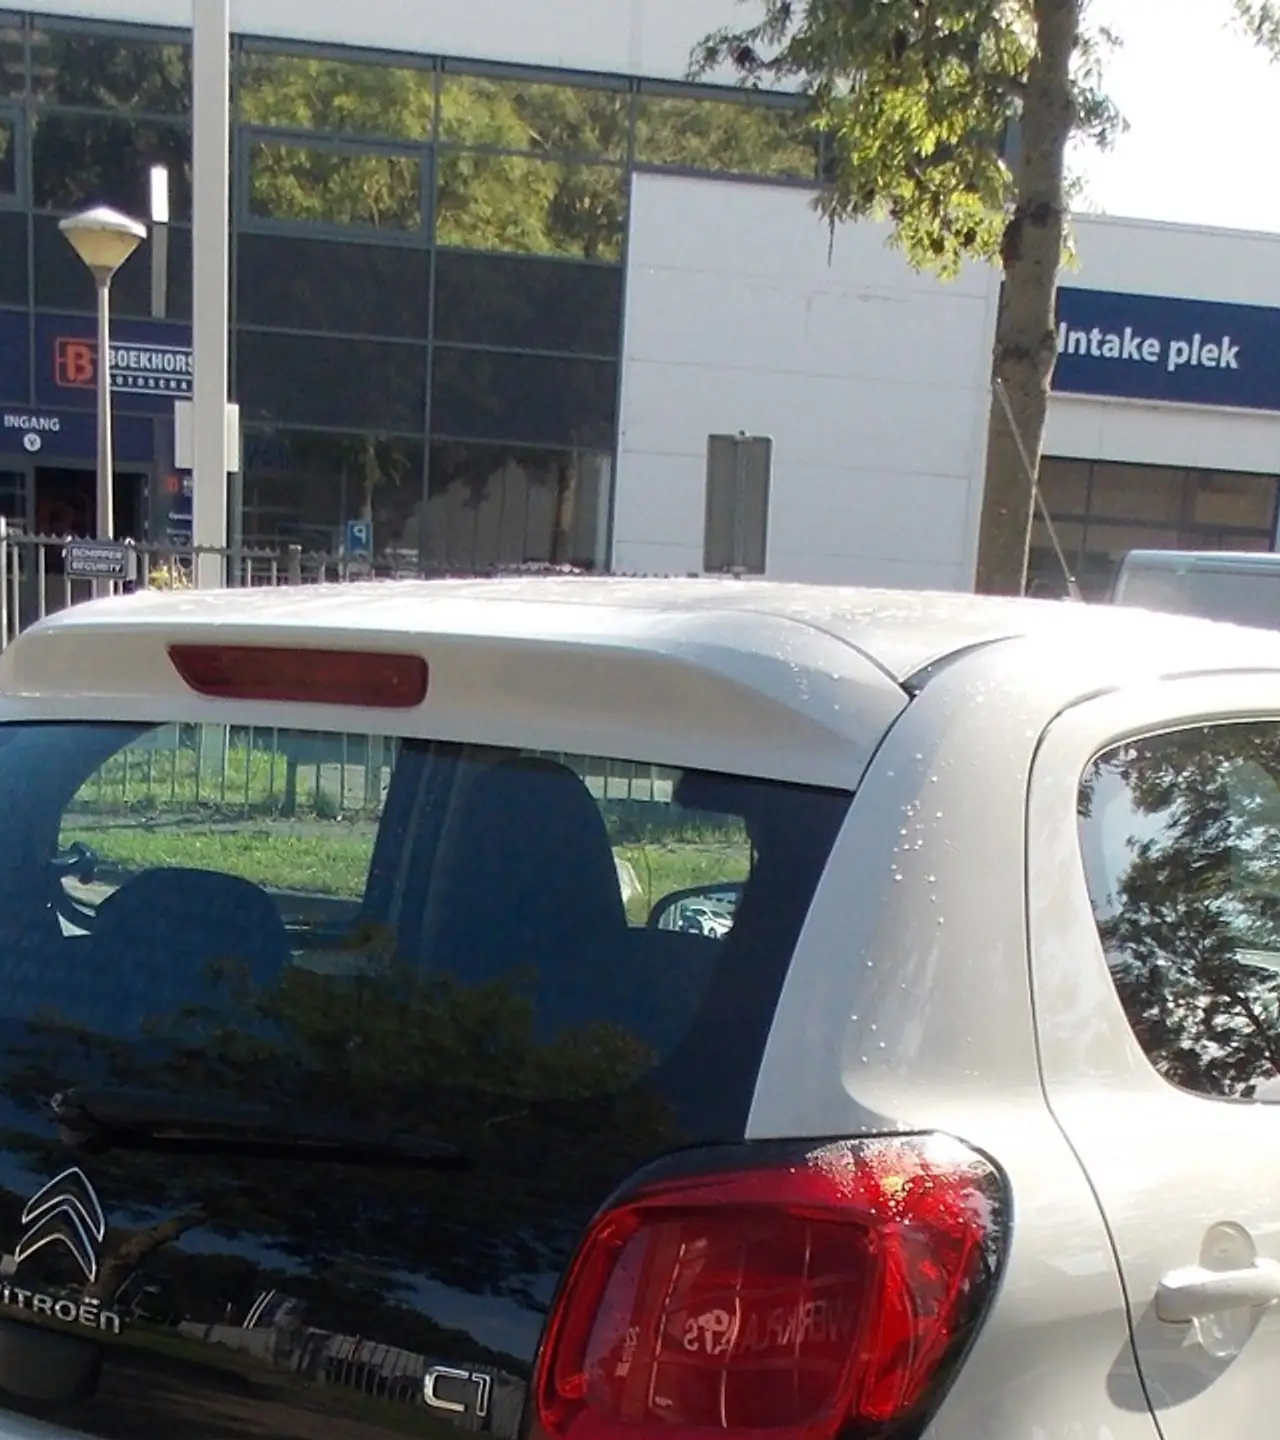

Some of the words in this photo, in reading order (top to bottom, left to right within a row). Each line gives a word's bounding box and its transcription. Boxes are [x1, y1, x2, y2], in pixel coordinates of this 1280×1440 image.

[1057, 321, 1161, 363] Intake
[1166, 332, 1241, 372] plek
[3, 414, 60, 431] INGANG
[423, 1364, 492, 1417] C1
